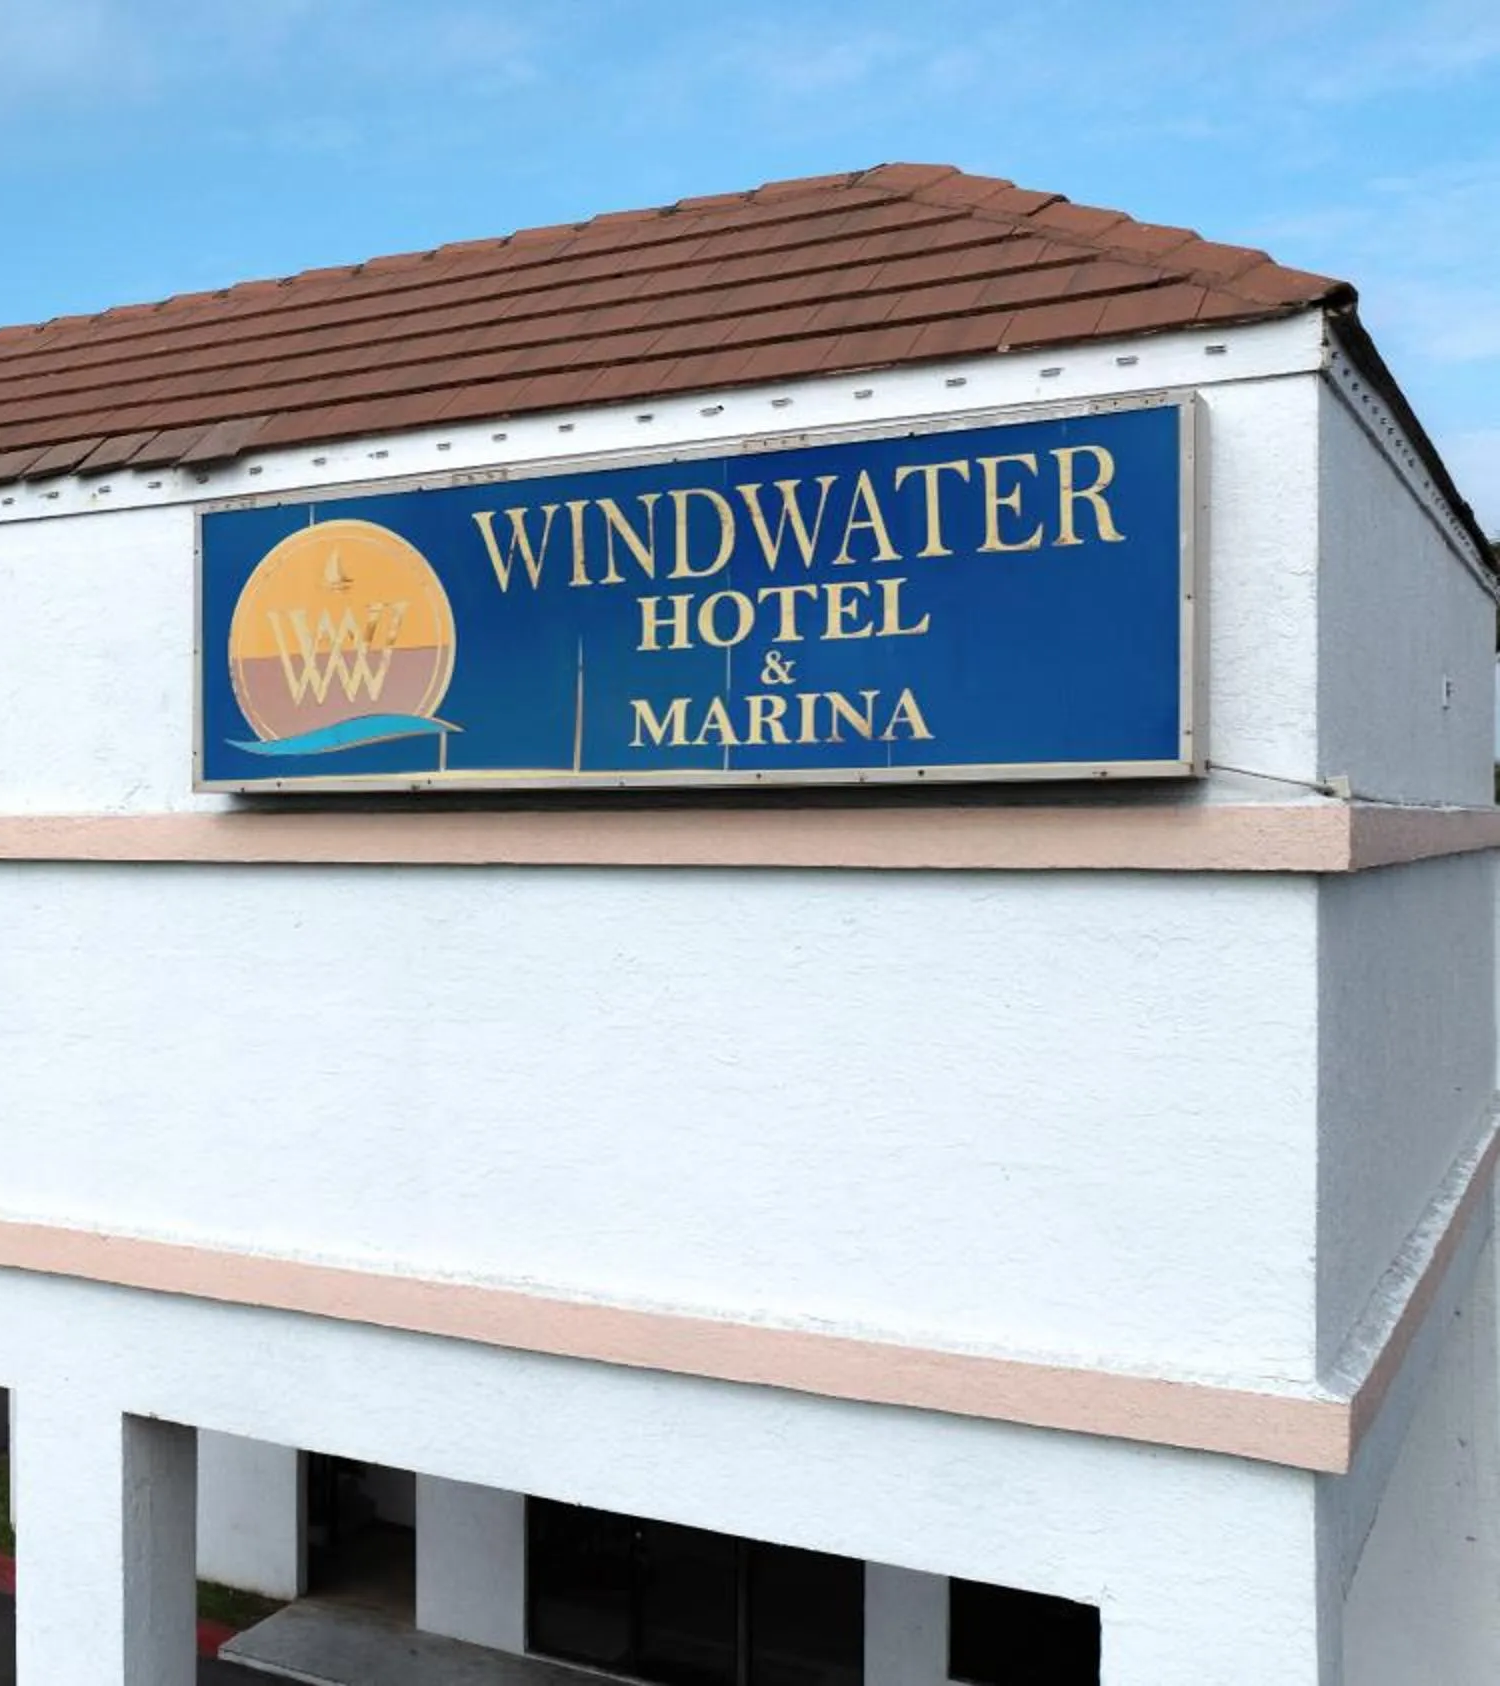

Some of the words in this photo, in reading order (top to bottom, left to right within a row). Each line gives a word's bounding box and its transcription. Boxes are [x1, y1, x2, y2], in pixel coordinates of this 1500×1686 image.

[471, 445, 1126, 593] WINDWATER
[636, 577, 931, 652] HOTEL
[760, 650, 796, 686] &
[629, 687, 935, 748] MARINA
